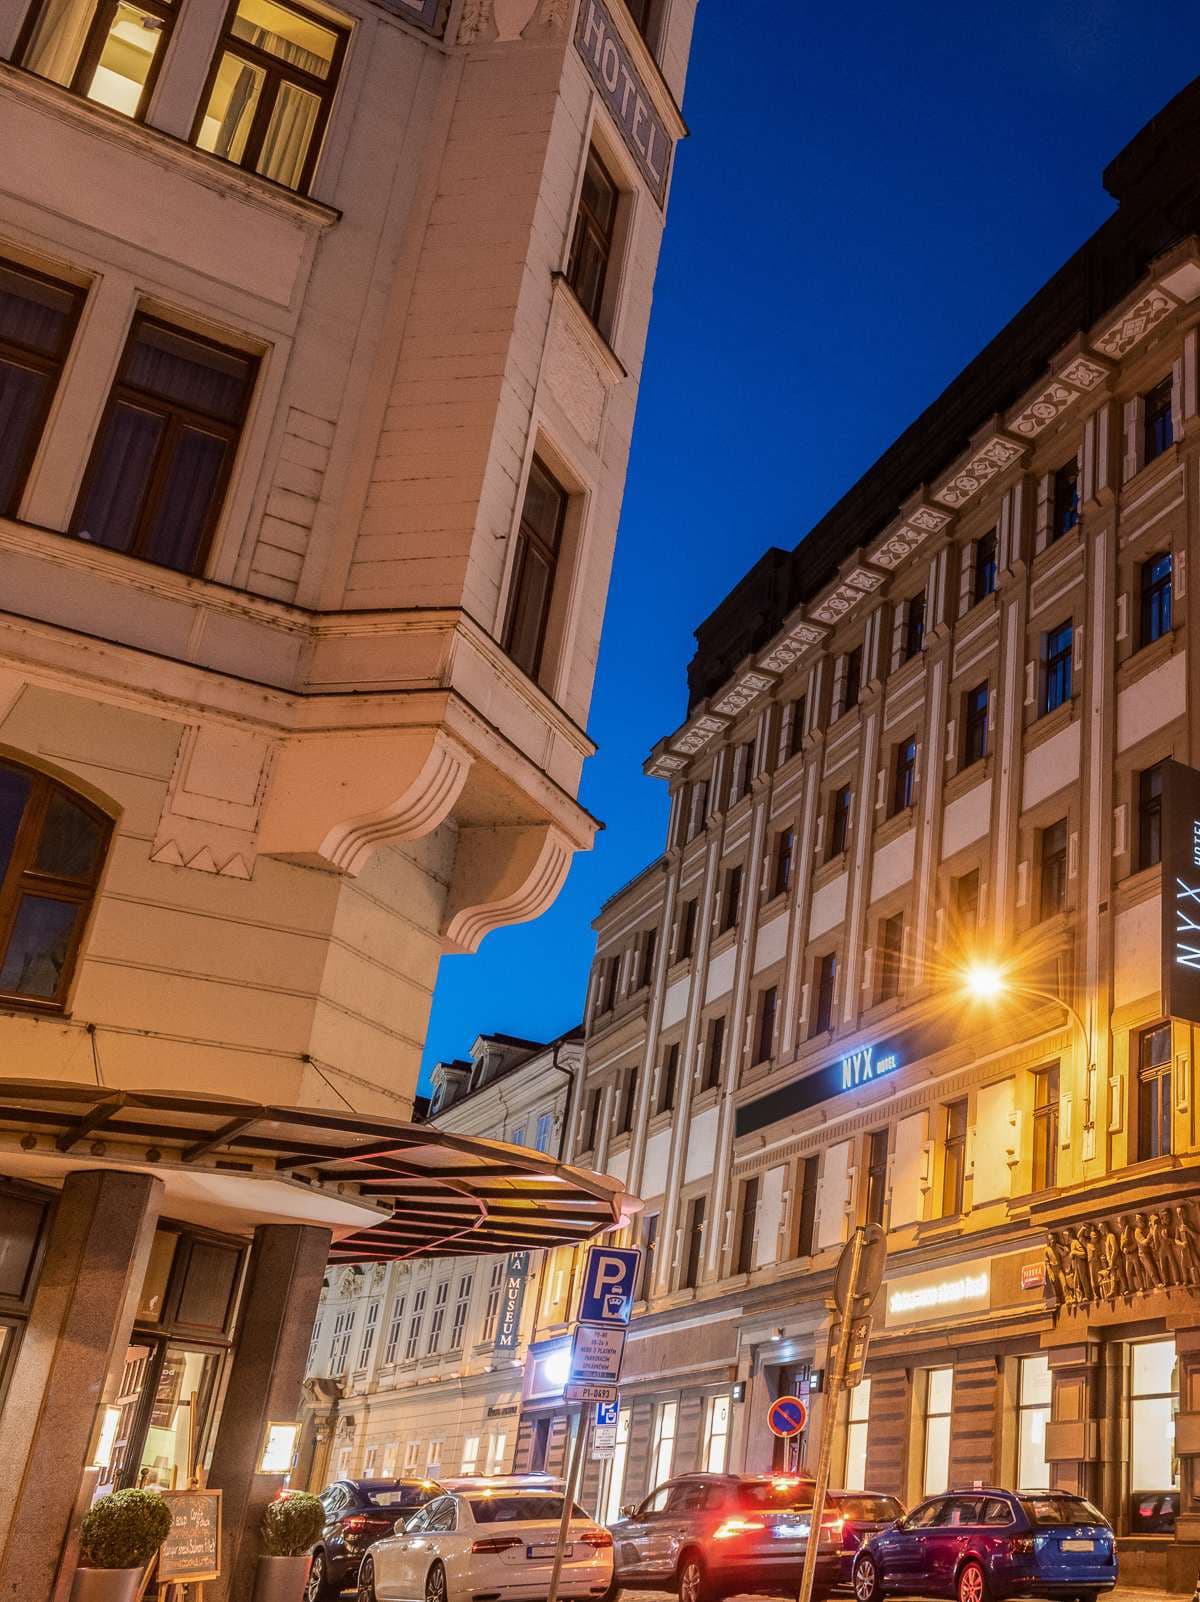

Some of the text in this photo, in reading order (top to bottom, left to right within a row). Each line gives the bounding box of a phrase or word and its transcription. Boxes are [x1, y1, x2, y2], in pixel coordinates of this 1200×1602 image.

[583, 0, 660, 185] HOTEL
[842, 1047, 873, 1089] NYX
[593, 1256, 627, 1300] P
[500, 1277, 521, 1346] MUSEUM
